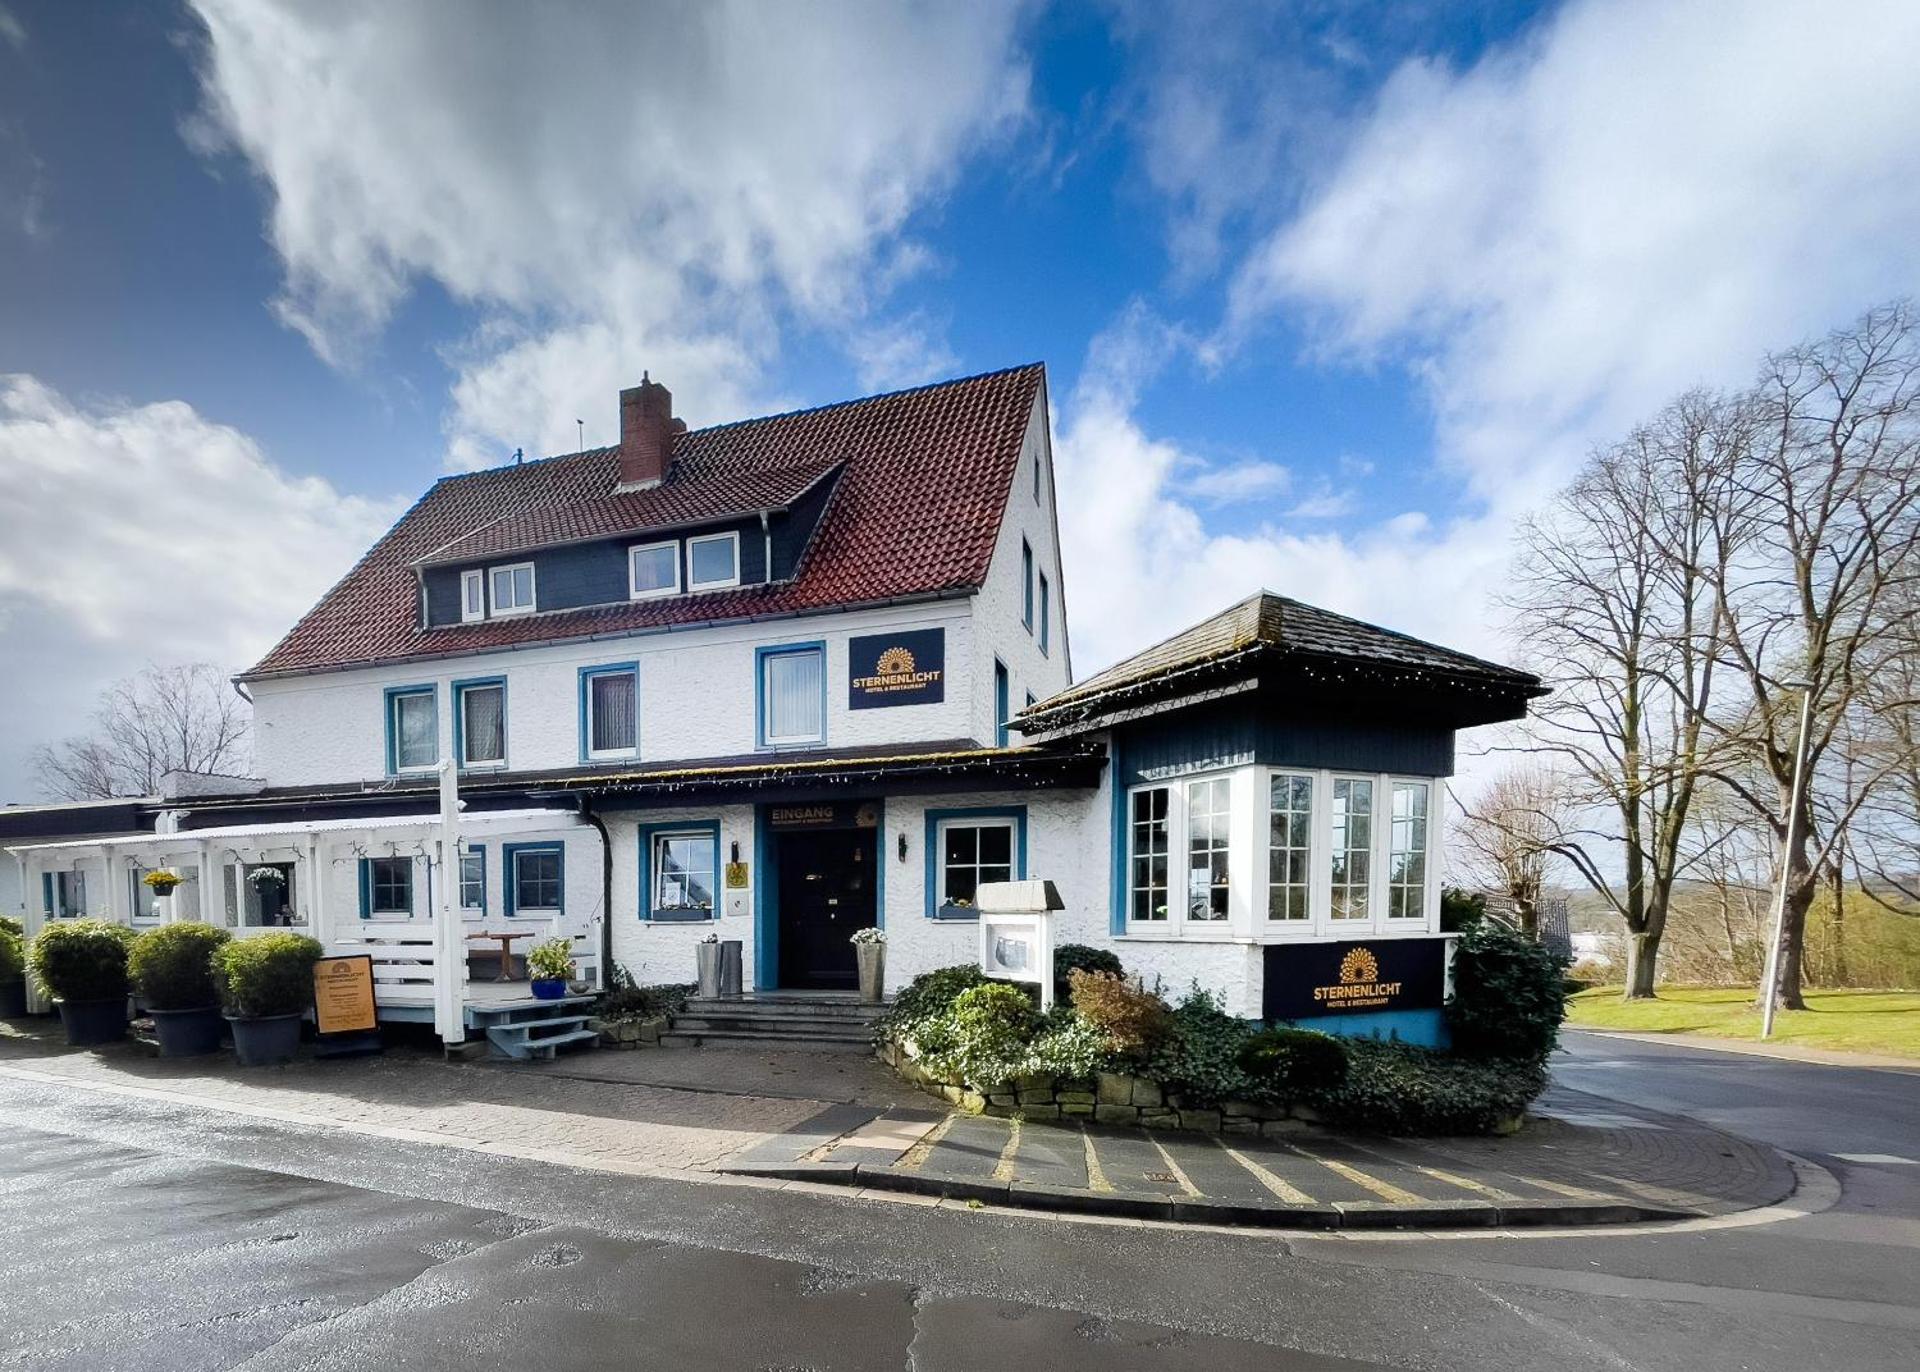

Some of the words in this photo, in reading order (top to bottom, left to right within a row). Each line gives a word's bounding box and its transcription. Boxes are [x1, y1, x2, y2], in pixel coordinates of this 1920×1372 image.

[853, 671, 941, 688] STERNENLICHT
[772, 807, 833, 820] EINGANG
[1313, 982, 1402, 1000] STERNENLICHT
